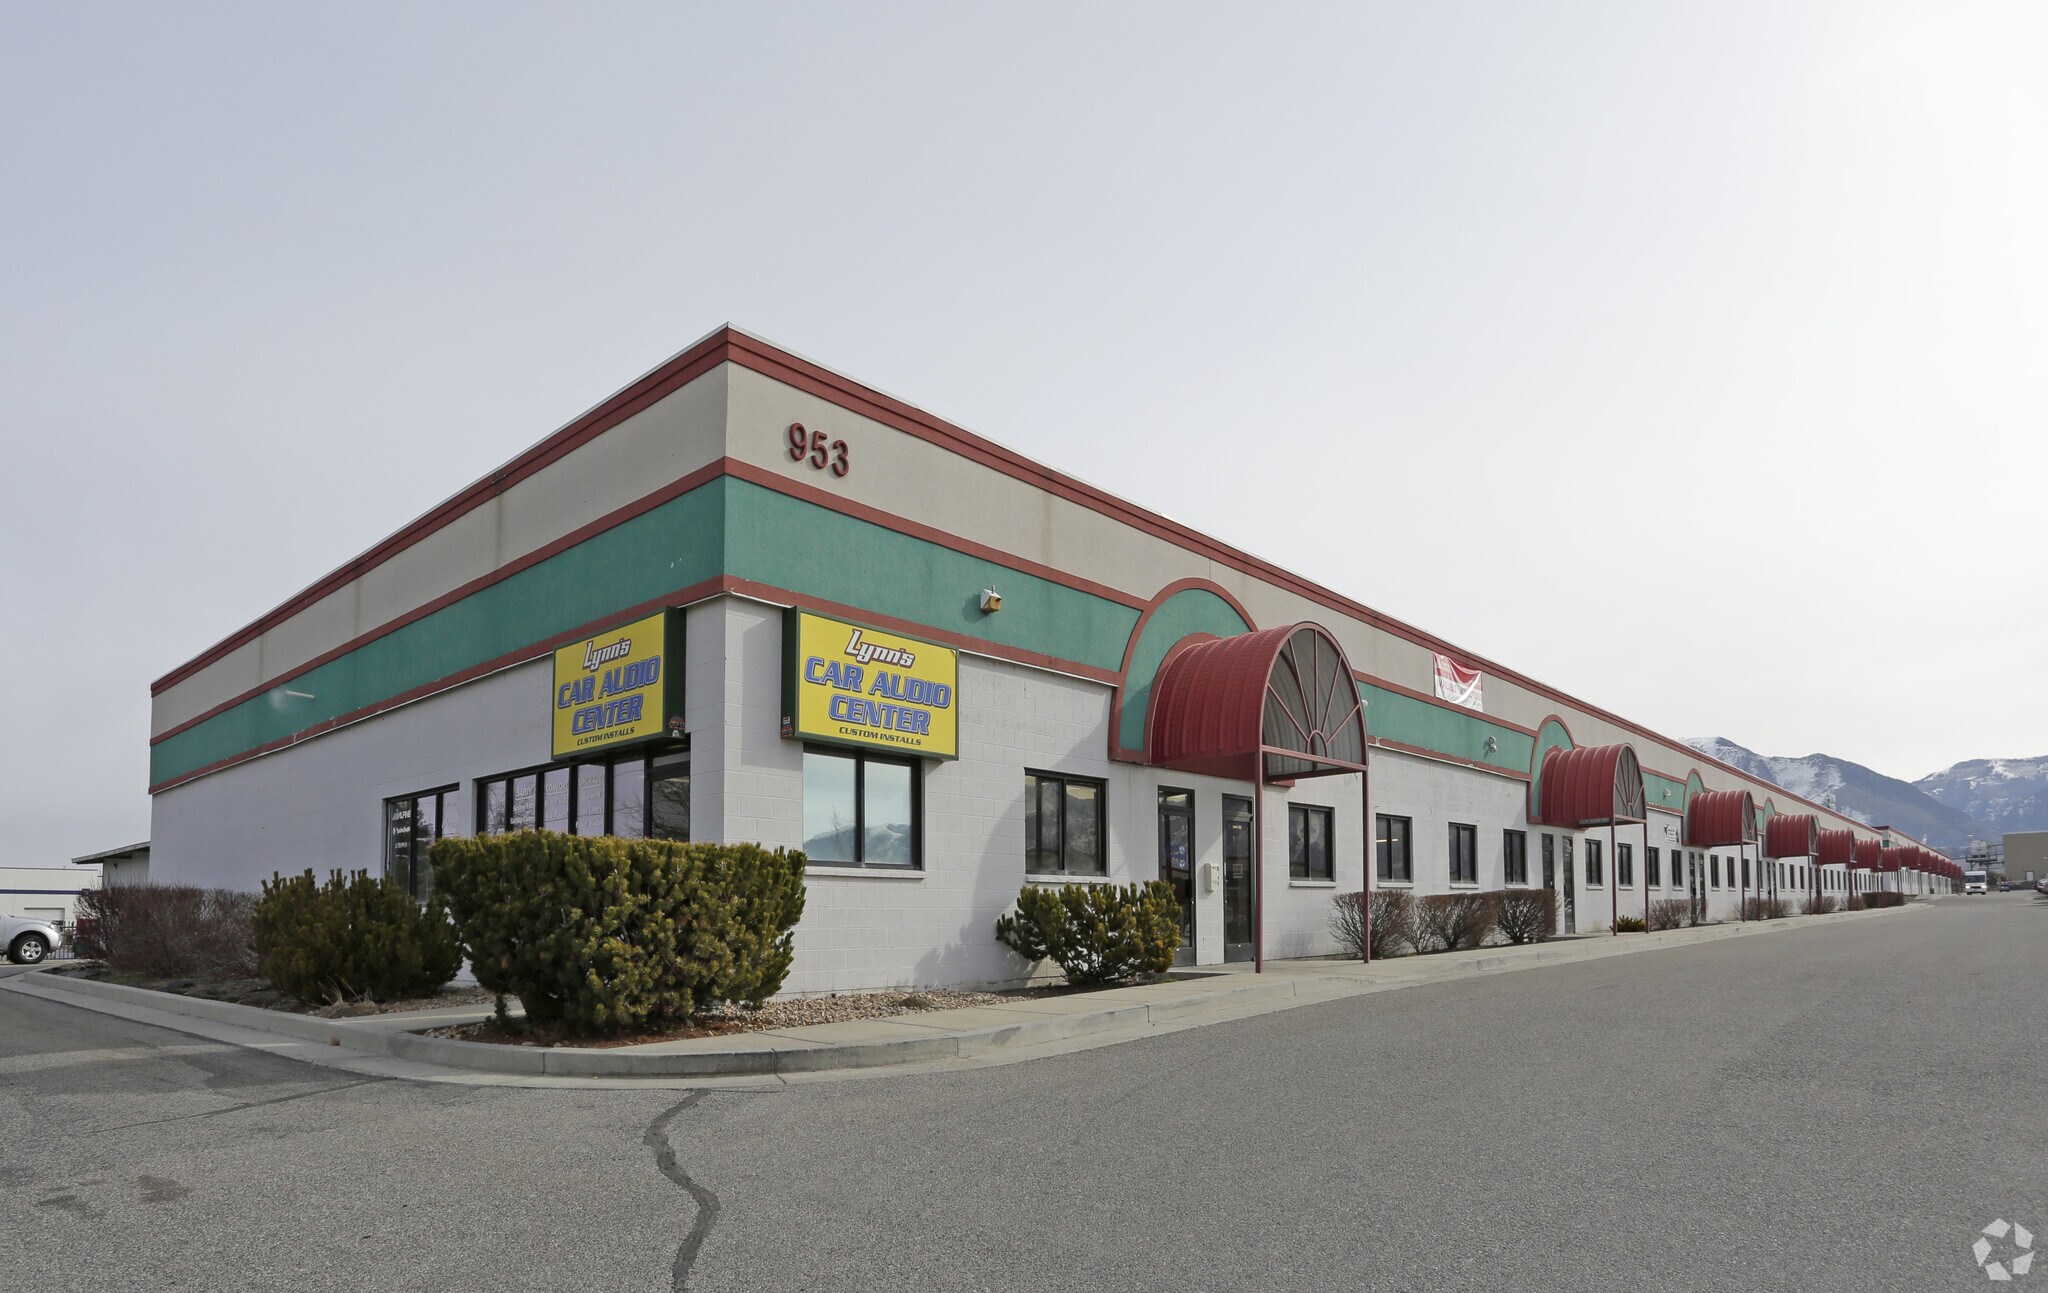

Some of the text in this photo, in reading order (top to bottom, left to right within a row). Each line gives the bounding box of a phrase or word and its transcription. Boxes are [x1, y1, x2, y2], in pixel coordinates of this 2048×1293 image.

[788, 422, 849, 477] 953
[583, 638, 631, 673] Lynn's
[845, 628, 915, 668] Lynn's
[558, 655, 661, 709] CAR AUDIO
[804, 656, 951, 708] CAR AUDIO
[572, 693, 643, 735] CENTER
[829, 693, 931, 736] CENTER
[576, 727, 635, 746] CUSTOM INSTALLS
[839, 726, 922, 746] CUSTOM INSTALLS
